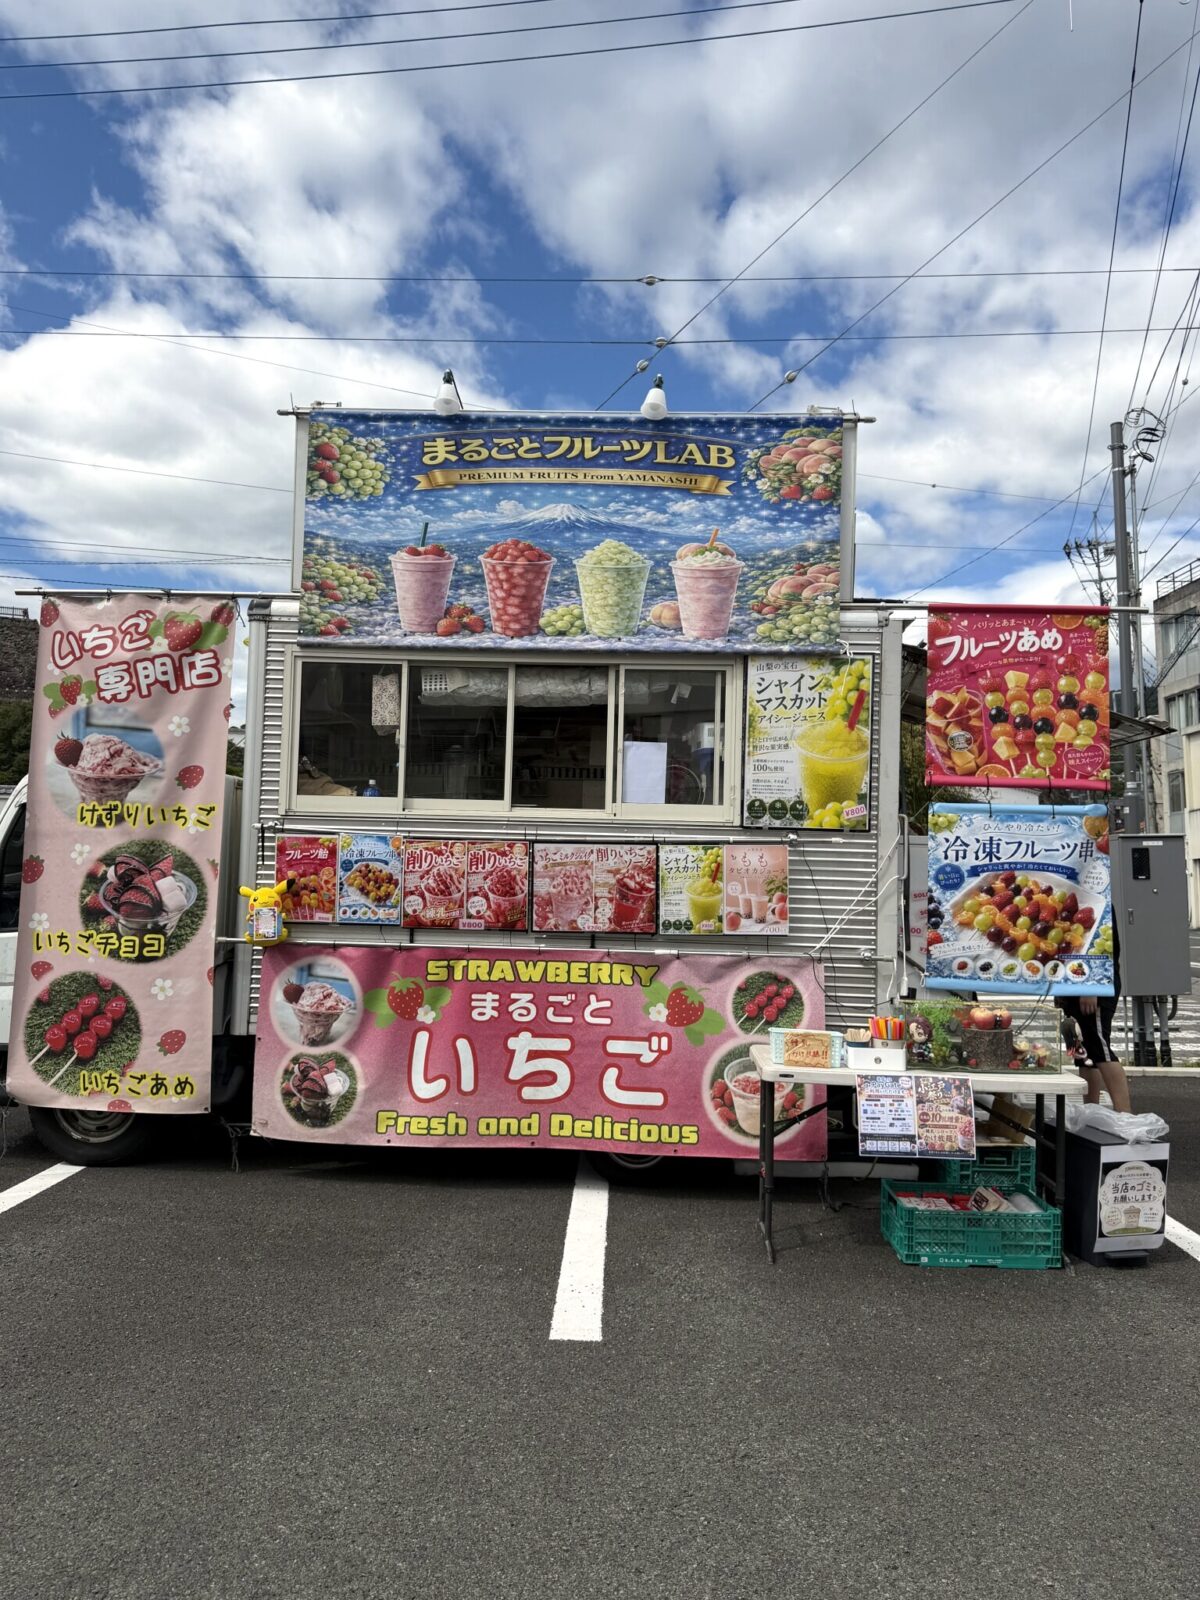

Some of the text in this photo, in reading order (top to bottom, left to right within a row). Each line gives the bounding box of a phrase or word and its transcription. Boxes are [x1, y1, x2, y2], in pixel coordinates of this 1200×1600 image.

[422, 435, 735, 469] まるごとフルーツLAB
[459, 469, 698, 486] PREMIUM FRUITS From YAMANASHI
[50, 609, 156, 668] いちご
[934, 626, 1063, 667] フルーツあめ
[95, 651, 221, 703] 専門店
[756, 673, 825, 695] シャイン
[755, 691, 828, 711] マスカット
[757, 712, 826, 724] アイシージュース
[78, 802, 216, 829] けずりいちご
[844, 806, 865, 817] ¥800
[285, 849, 329, 860] フルーツ飴
[406, 849, 464, 871] 削りいちご
[469, 850, 527, 872] 削りいちご
[596, 846, 647, 862] 削りいちご
[664, 854, 700, 866] シャイン
[942, 835, 1095, 863] 冷凍フルーツ串
[664, 864, 702, 875] マスカット
[34, 930, 166, 959] いちごチョコ
[425, 958, 659, 986] STRAWBERRY
[470, 991, 613, 1026] まるごと
[407, 1028, 671, 1109] いちご
[80, 1071, 195, 1098] いちごあめ
[376, 1110, 699, 1145] Fresh and Delicious
[1111, 1180, 1156, 1194] 当店のゴミを
